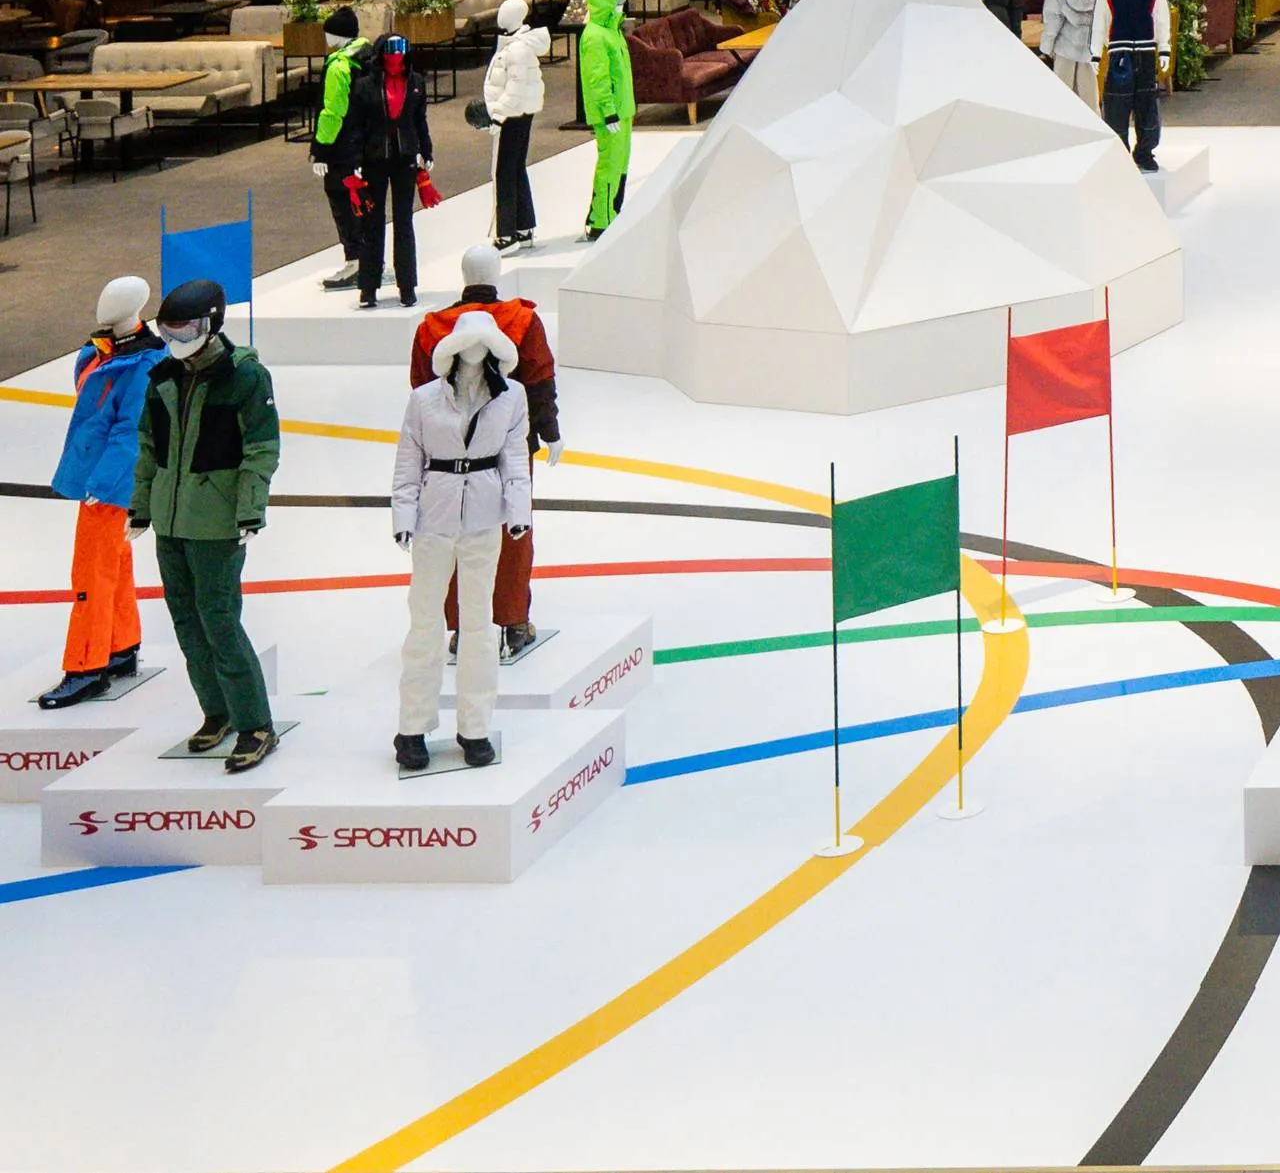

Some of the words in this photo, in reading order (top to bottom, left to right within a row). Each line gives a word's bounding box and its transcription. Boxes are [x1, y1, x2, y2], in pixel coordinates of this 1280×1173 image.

[584, 647, 643, 707] SPORTLAND
[548, 746, 614, 816] SPORTLAND
[114, 810, 256, 832] SPORTLAND
[334, 827, 477, 848] SPORTLAND
